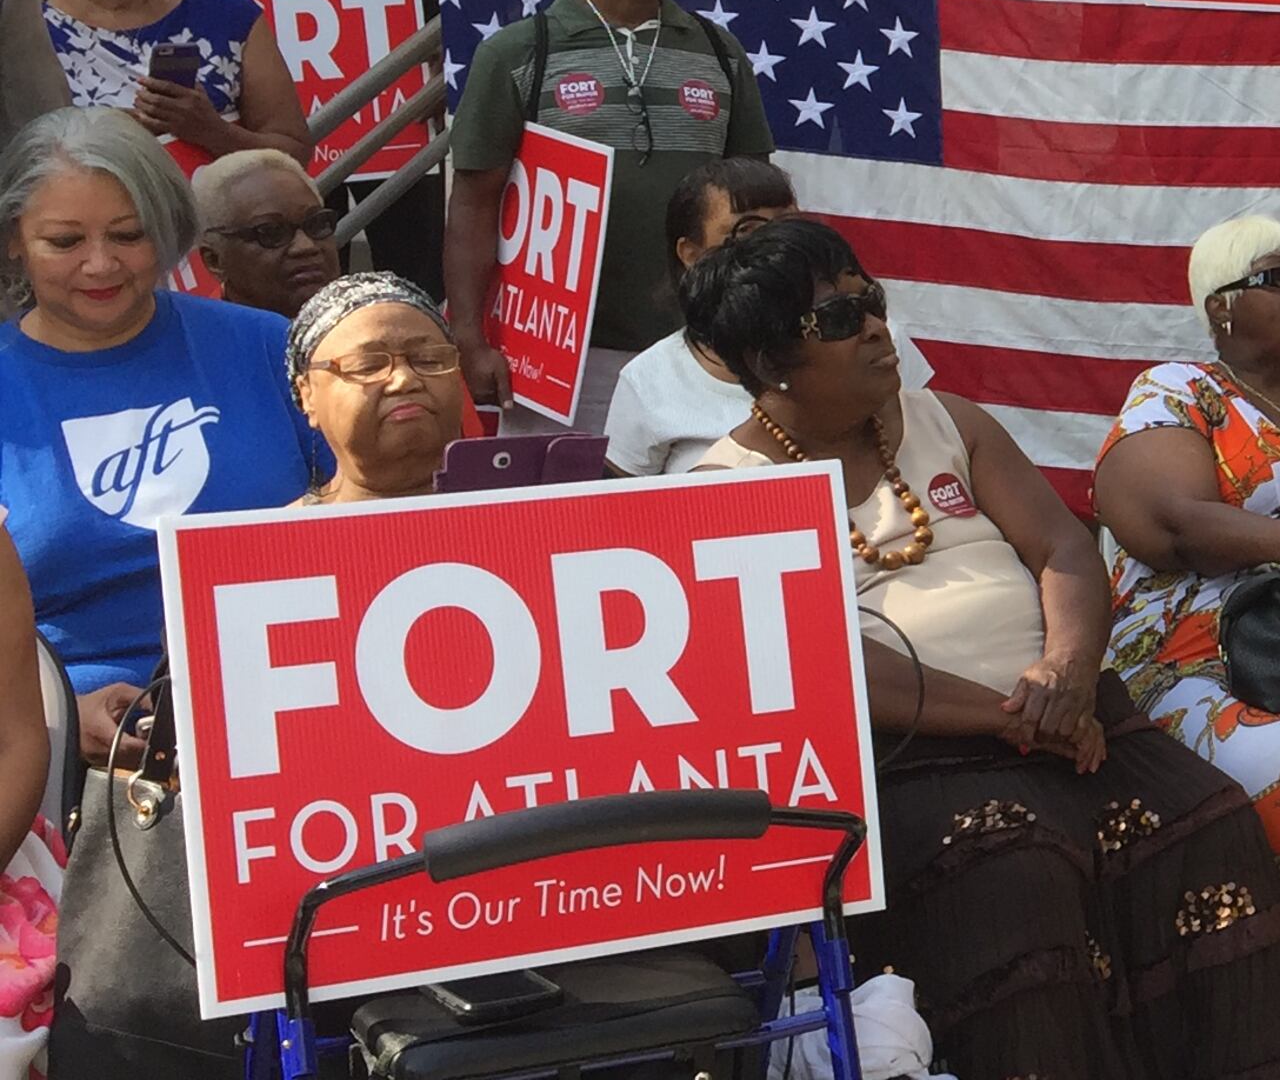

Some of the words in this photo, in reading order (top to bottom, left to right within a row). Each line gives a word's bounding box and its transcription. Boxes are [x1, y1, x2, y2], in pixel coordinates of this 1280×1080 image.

[559, 80, 597, 94] FORT
[683, 86, 715, 100] FORT
[497, 157, 600, 294] ORT
[490, 281, 577, 354] ATLANTA
[90, 401, 221, 520] aft
[929, 481, 961, 503] FORT
[212, 527, 823, 780] FORT
[231, 792, 419, 884] FOR
[379, 901, 434, 942] It's
[447, 891, 520, 931] Our
[533, 876, 623, 921] Time
[634, 854, 728, 904] Now!
